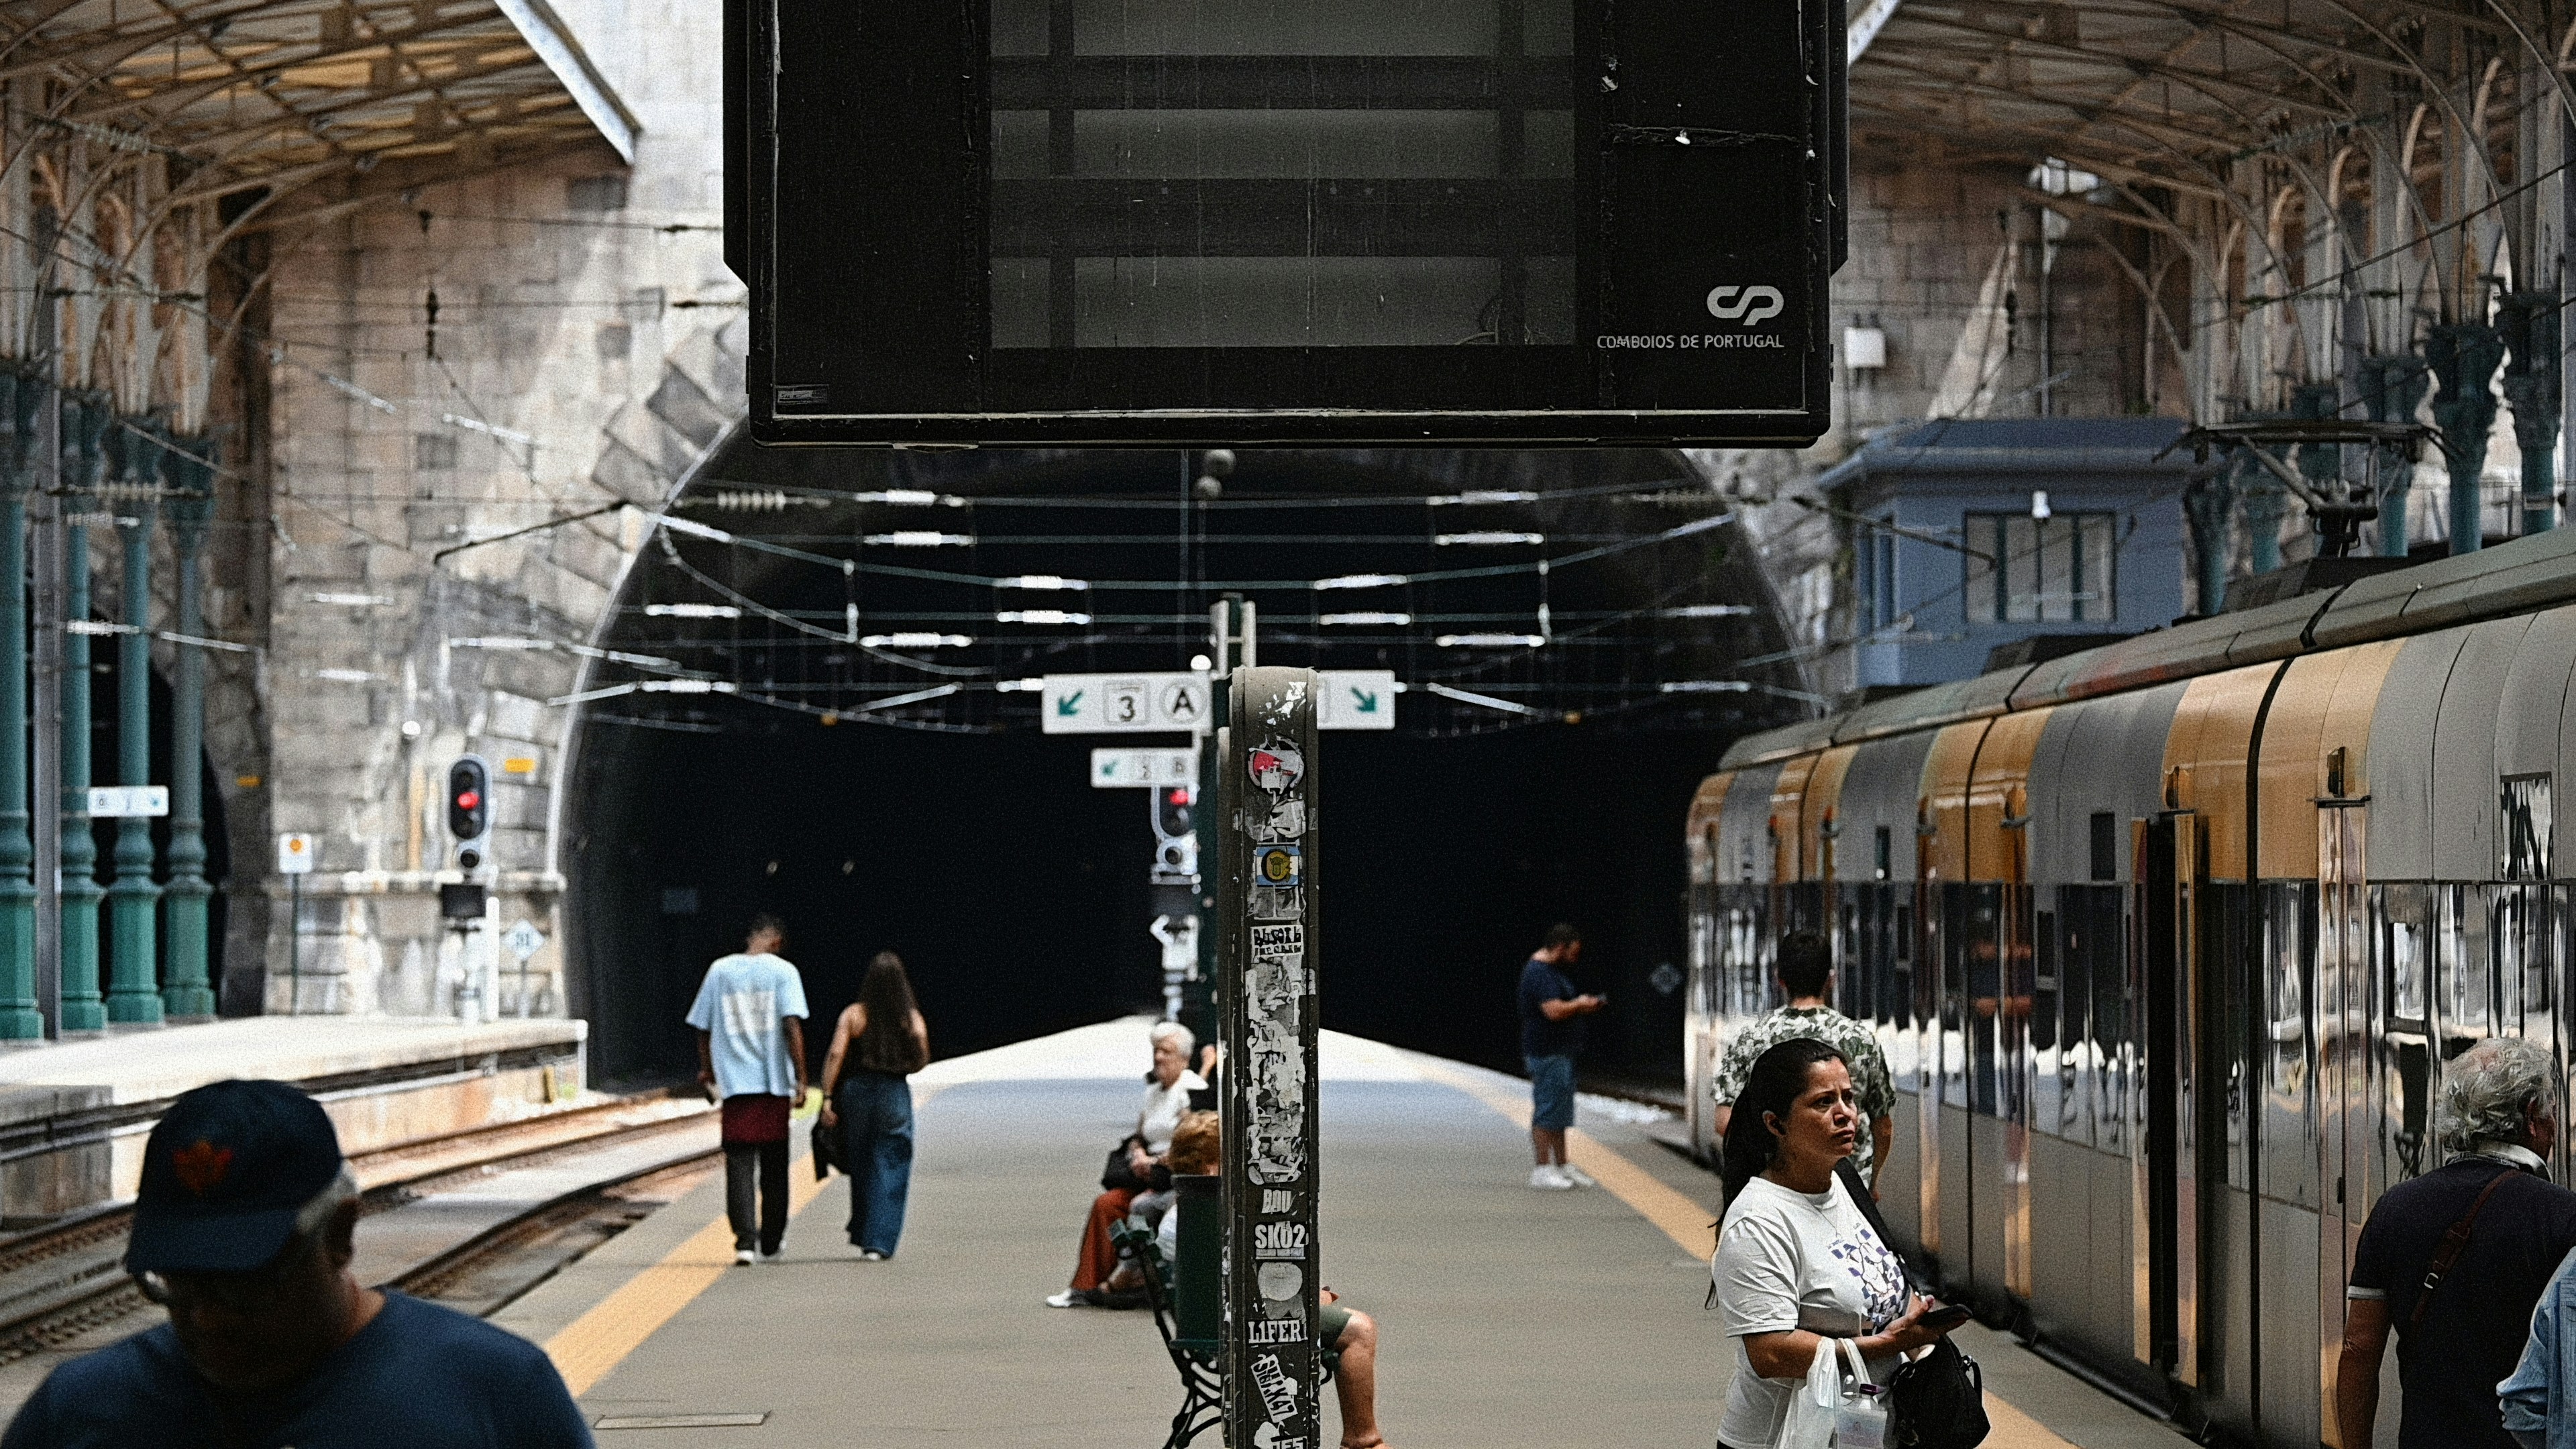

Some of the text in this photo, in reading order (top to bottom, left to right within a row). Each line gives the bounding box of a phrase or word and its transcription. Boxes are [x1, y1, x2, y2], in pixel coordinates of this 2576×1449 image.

[1597, 333, 1785, 349] COMBOIOS DE PORTUGAL
[1120, 687, 1195, 722] 3 A
